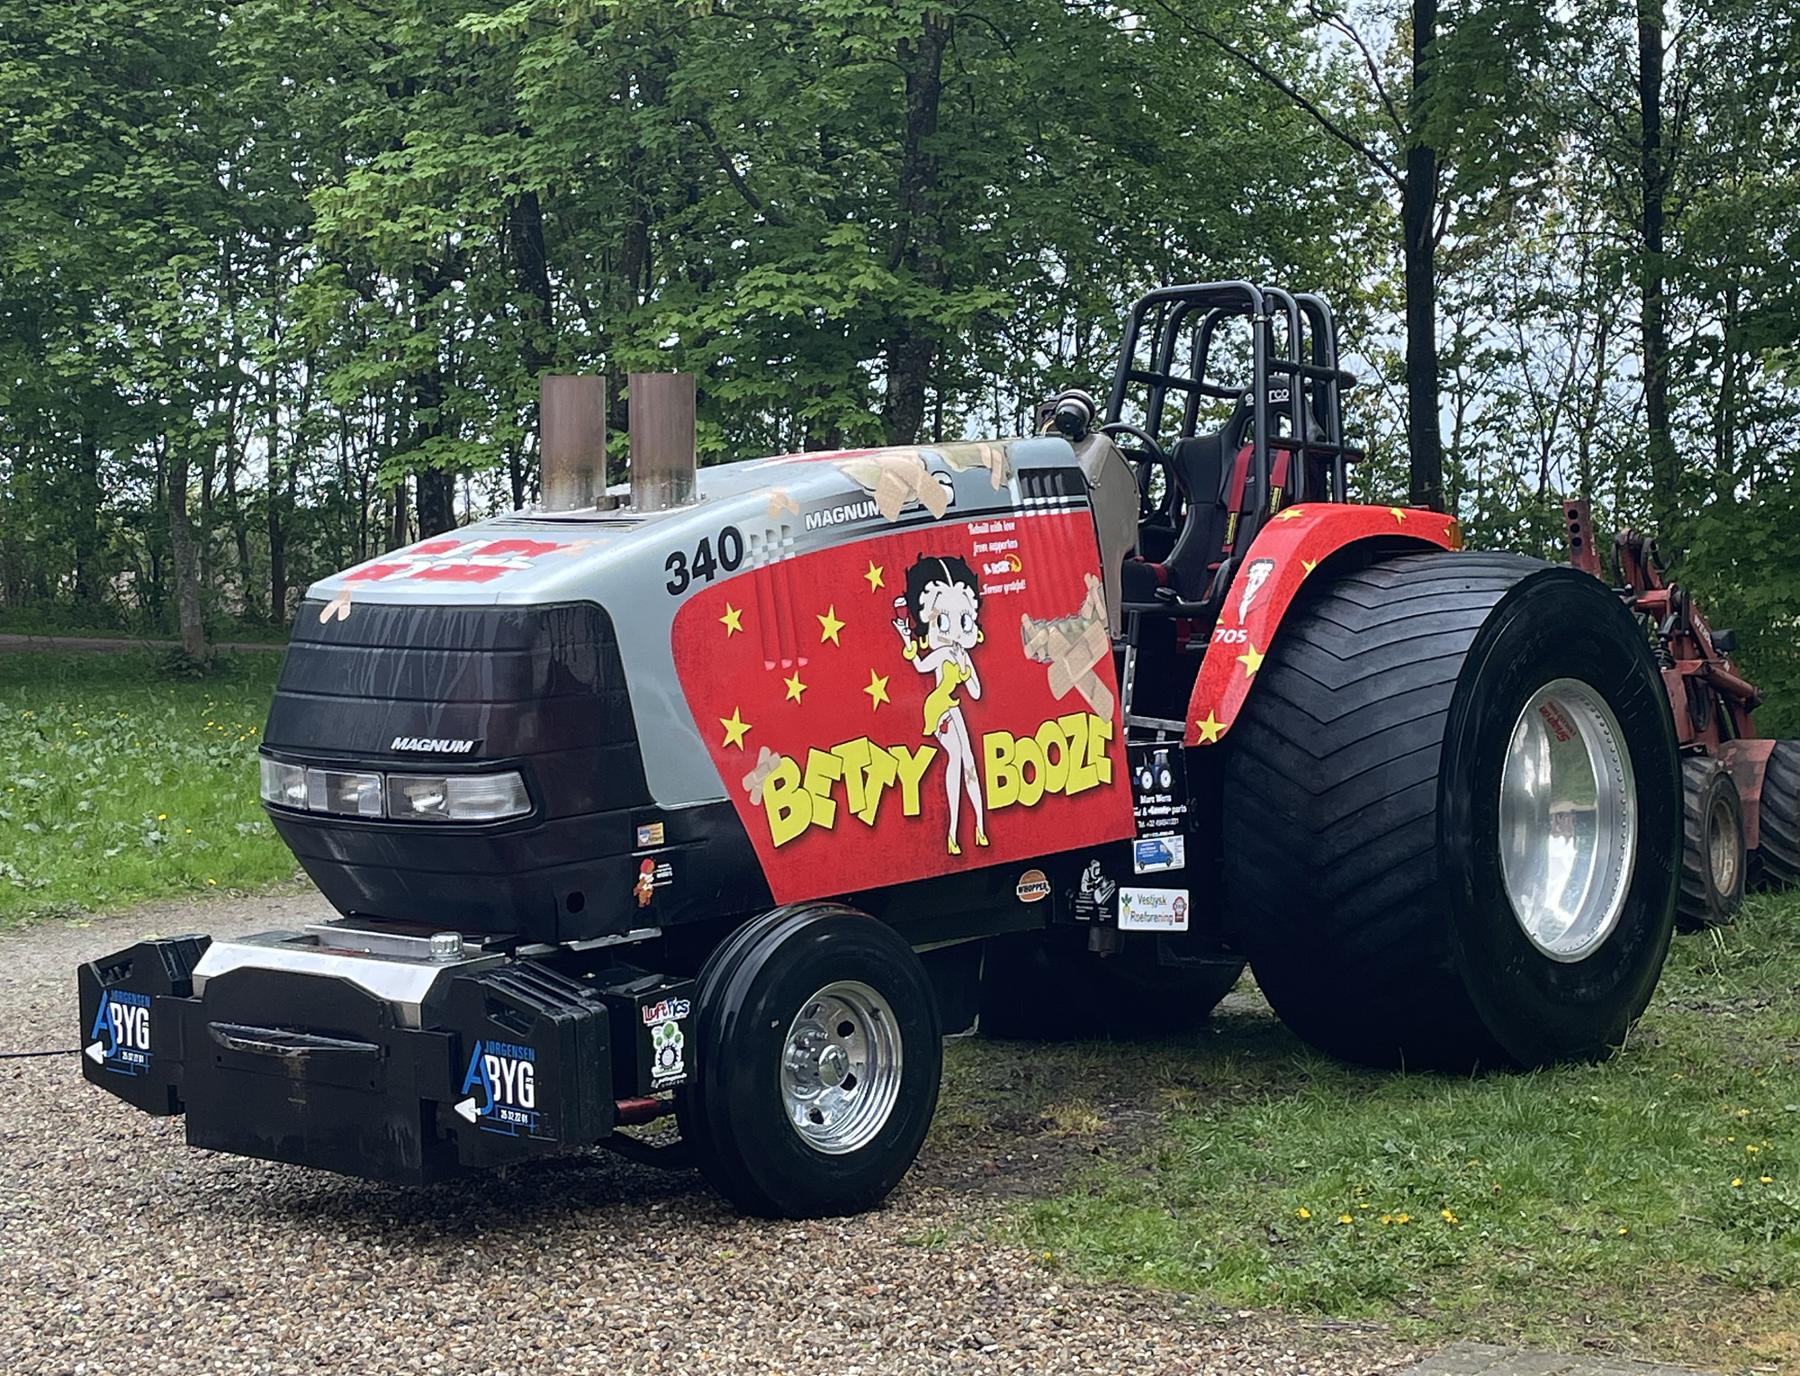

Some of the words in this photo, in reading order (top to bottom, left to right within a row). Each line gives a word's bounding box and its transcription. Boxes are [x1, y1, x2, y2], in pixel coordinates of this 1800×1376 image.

[805, 500, 880, 531] MAGNUM
[989, 520, 1003, 532] with
[665, 525, 744, 596] 340
[1215, 629, 1248, 644] 705
[391, 737, 473, 753] MAGNUM
[762, 736, 938, 848] BETTY
[983, 711, 1113, 810] BOOZE
[1018, 881, 1048, 894] WHOPPER
[1137, 894, 1167, 908] Vestjysk
[109, 1002, 150, 1050] BYG
[484, 1054, 535, 1108] BYG
